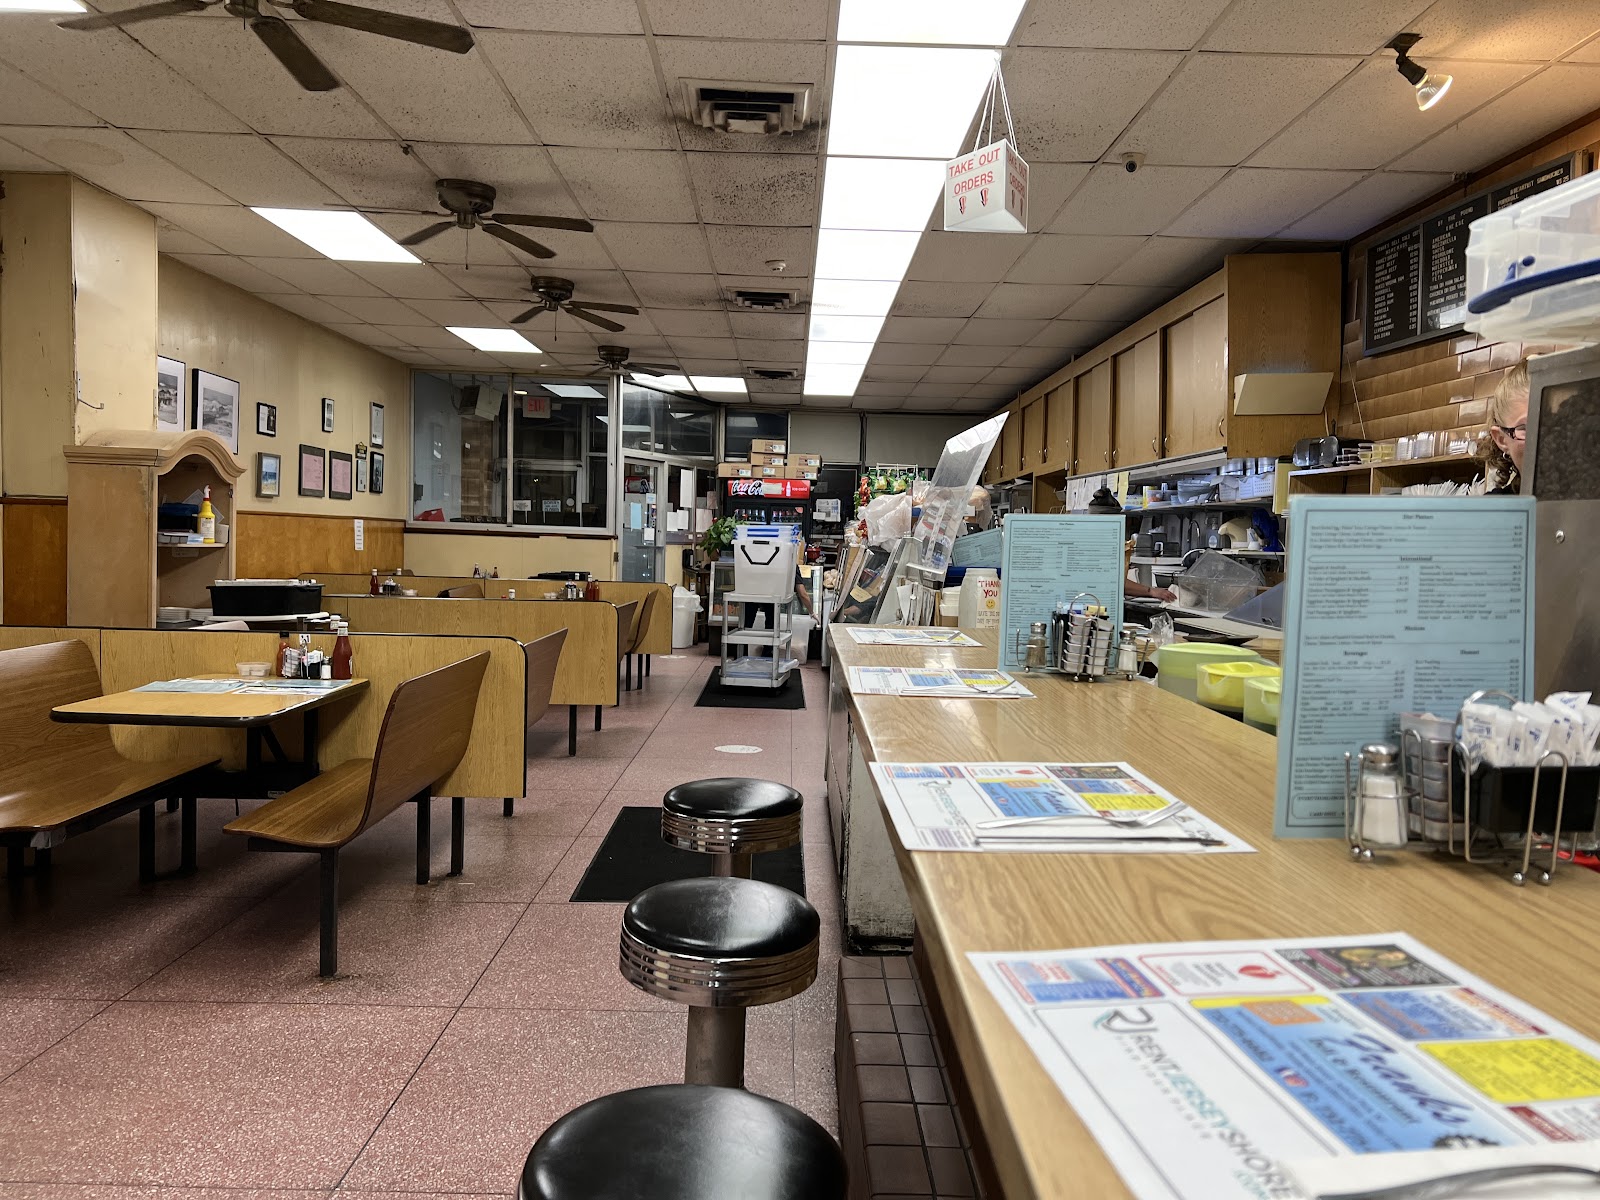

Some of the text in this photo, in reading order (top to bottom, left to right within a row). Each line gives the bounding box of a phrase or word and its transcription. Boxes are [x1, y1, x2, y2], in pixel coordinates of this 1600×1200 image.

[949, 148, 1001, 178] TAKE OUT
[954, 171, 993, 195] ORDERS
[527, 398, 545, 412] EXIT
[983, 589, 998, 598] YOU
